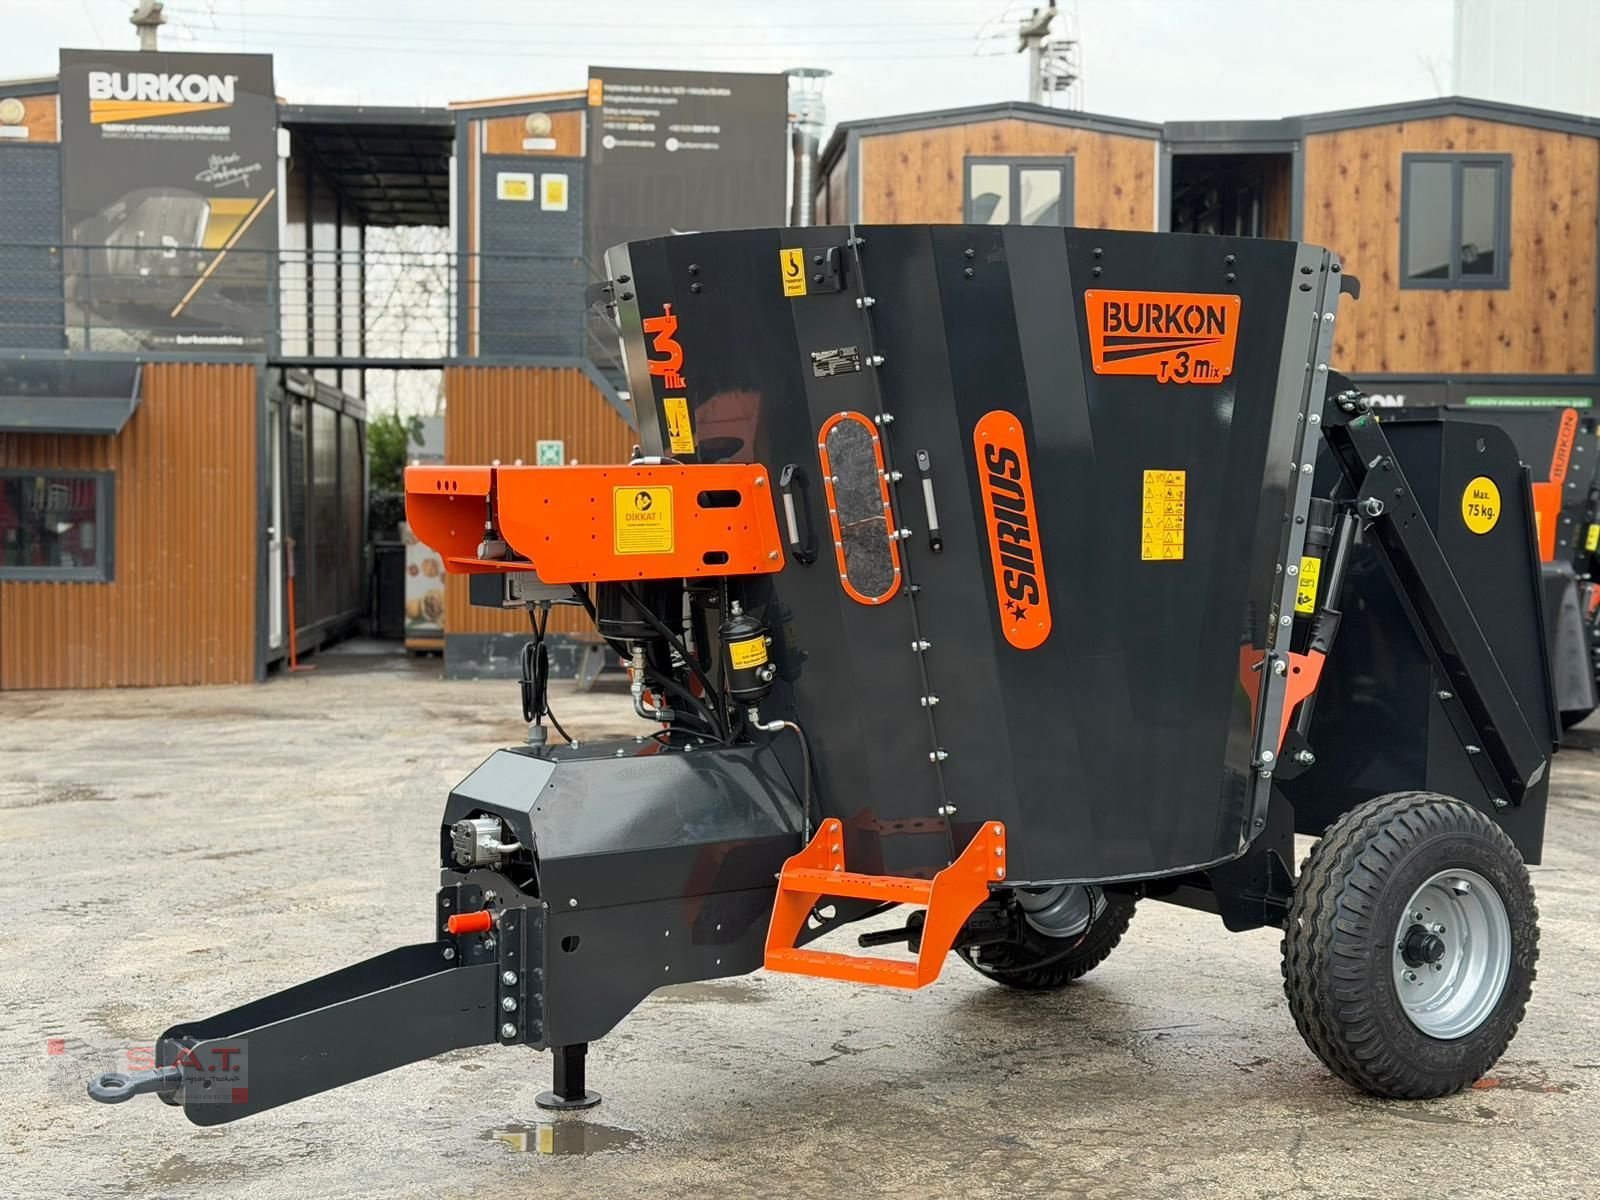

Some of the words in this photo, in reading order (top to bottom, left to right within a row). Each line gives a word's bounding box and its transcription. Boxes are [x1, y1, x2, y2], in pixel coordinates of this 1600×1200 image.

[88, 71, 235, 103] BURKON
[1103, 301, 1226, 335] BURKON
[1160, 360, 1169, 378] T
[1173, 351, 1191, 379] 3
[1553, 415, 1575, 478] BURKON
[1473, 489, 1490, 500] Max.
[625, 510, 656, 521] DİKKAT
[984, 442, 1040, 606] SIRIUS
[1468, 503, 1480, 517] 75
[1481, 503, 1496, 520] kg.
